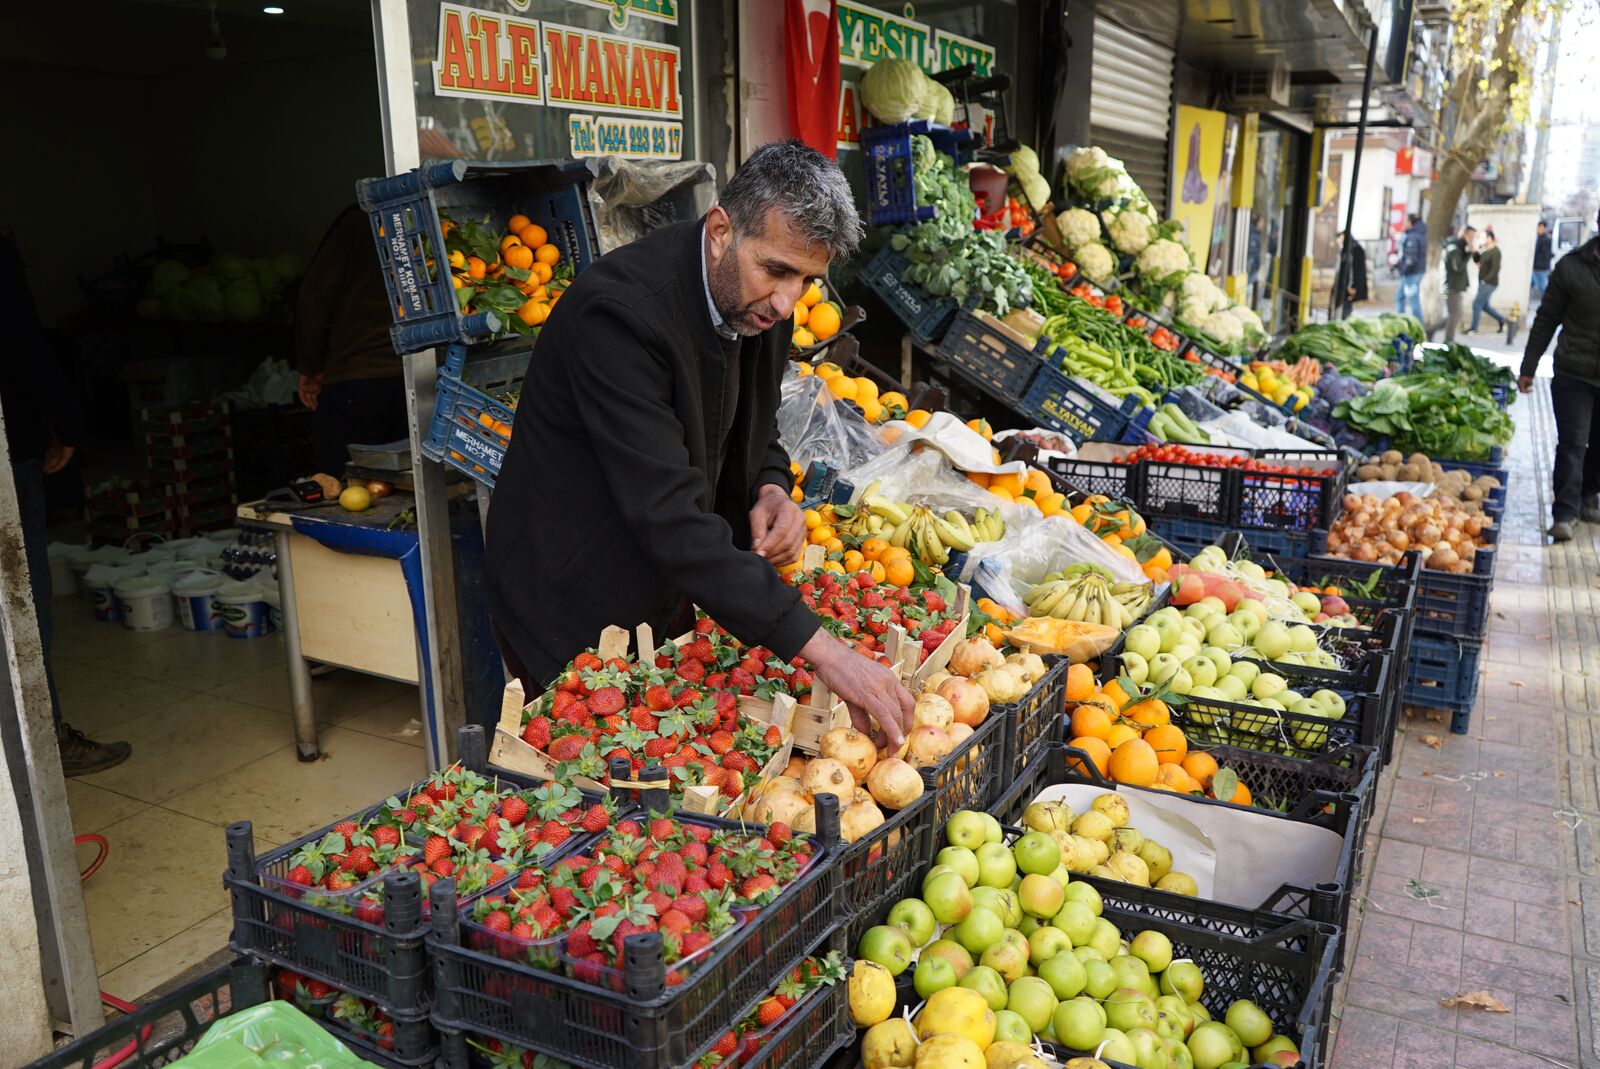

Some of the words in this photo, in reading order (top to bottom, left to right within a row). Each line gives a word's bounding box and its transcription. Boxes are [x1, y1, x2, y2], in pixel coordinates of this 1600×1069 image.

[546, 28, 681, 115] MANAVI
[571, 119, 595, 152] Tel:
[598, 122, 627, 152] 0484
[629, 125, 651, 153] 223
[652, 126, 666, 153] 23
[668, 127, 681, 153] 17
[391, 237, 401, 261] NO:7
[392, 213, 411, 268] MERHAMET
[455, 428, 504, 461] MERHAMET
[464, 443, 486, 459] NO:7
